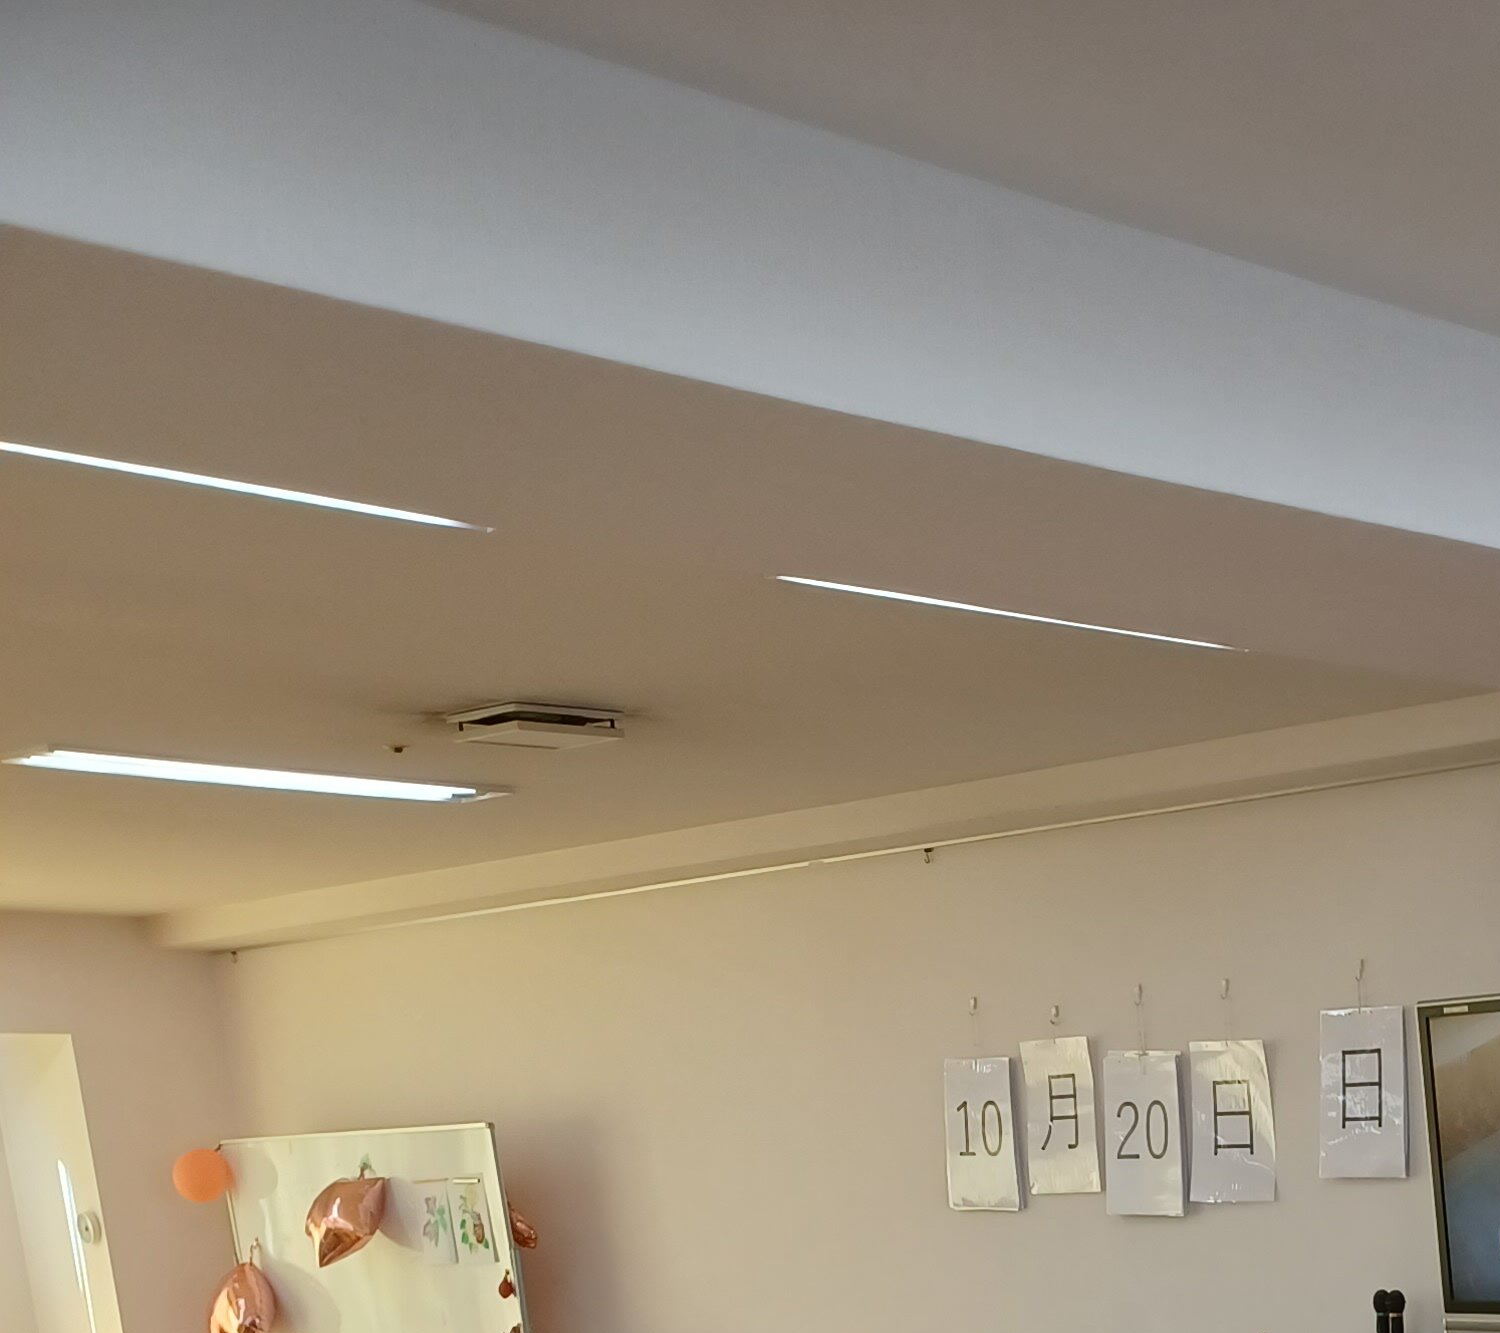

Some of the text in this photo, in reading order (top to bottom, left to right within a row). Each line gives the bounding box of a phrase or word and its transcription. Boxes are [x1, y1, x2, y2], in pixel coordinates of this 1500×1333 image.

[955, 1073, 1255, 1160] 10 月 20 日
[1340, 1048, 1383, 1129] 日
